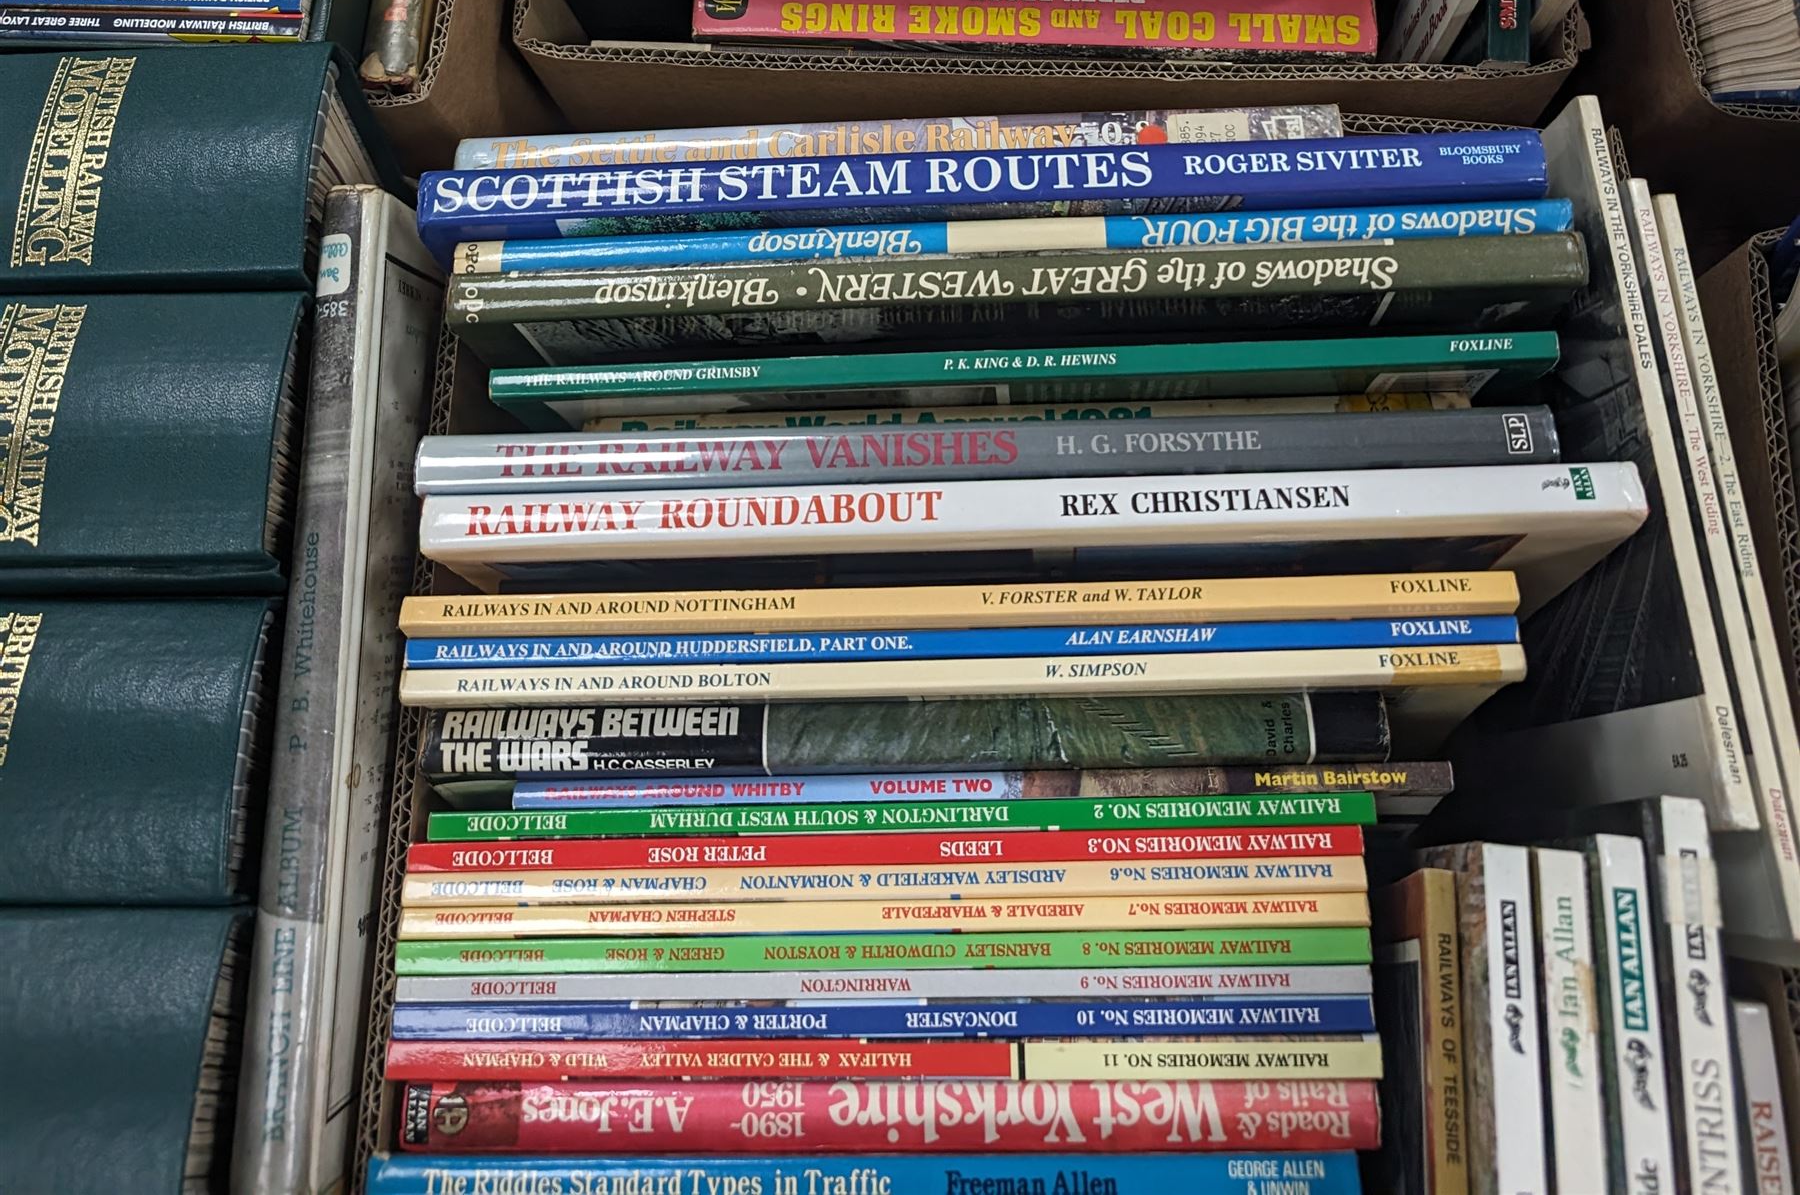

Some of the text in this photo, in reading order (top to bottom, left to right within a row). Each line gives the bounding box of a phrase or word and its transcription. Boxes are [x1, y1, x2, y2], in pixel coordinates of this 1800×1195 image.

[781, 3, 1360, 45] SMALL COAL AND SMOKE RINGS
[69, 57, 137, 266] BRITISH RAILWAY
[1439, 144, 1521, 158] BLOOMSBURY
[1461, 152, 1504, 165] BOOKS
[433, 147, 1422, 214] SCOTTISH STEAM ROUTES ROGER SIVITER
[1592, 127, 1653, 371] RAILWAYS IN THE YORKSHIRE DALES
[1125, 431, 1261, 453] FORSYTHE
[466, 485, 1350, 536] RAILWAY ROUNDABOUT REX CHRISTIANSEN
[442, 578, 1472, 618] RAILWAYS IN AND AROUND NOTTINGHAM FORSTER TAYLOR FOXLINE
[819, 636, 867, 652] PART
[871, 635, 913, 651] ONE.
[1065, 629, 1113, 646] ALAN
[1117, 627, 1216, 644] EARNSHAW
[698, 662, 1148, 688] BOLTON SIMPSON
[442, 706, 740, 740] RAILWAYS BETWEEN
[1716, 706, 1741, 785] Dalesman
[870, 768, 1407, 794] VOLUME TWO Martin Bairstow
[650, 806, 1009, 828] DARLINGTON SOUTH WEST DURHAM
[940, 840, 1003, 856] LEEDS
[1135, 835, 1242, 852] MEMORIES
[1249, 833, 1332, 850] RAILWAY
[452, 849, 553, 866] BELLCODE
[648, 847, 698, 863] ROSE
[703, 846, 767, 861] PETER
[882, 904, 1084, 919] AIREDALE WHARFEDALE
[965, 942, 1051, 957] BARNSLEY
[1614, 889, 1647, 1030] IAN ALLAN
[800, 978, 911, 993] WARRINGTON
[753, 1011, 1017, 1029] DONCASTER PORTER
[1438, 932, 1460, 1166] RAILWAYS TEESSIDE
